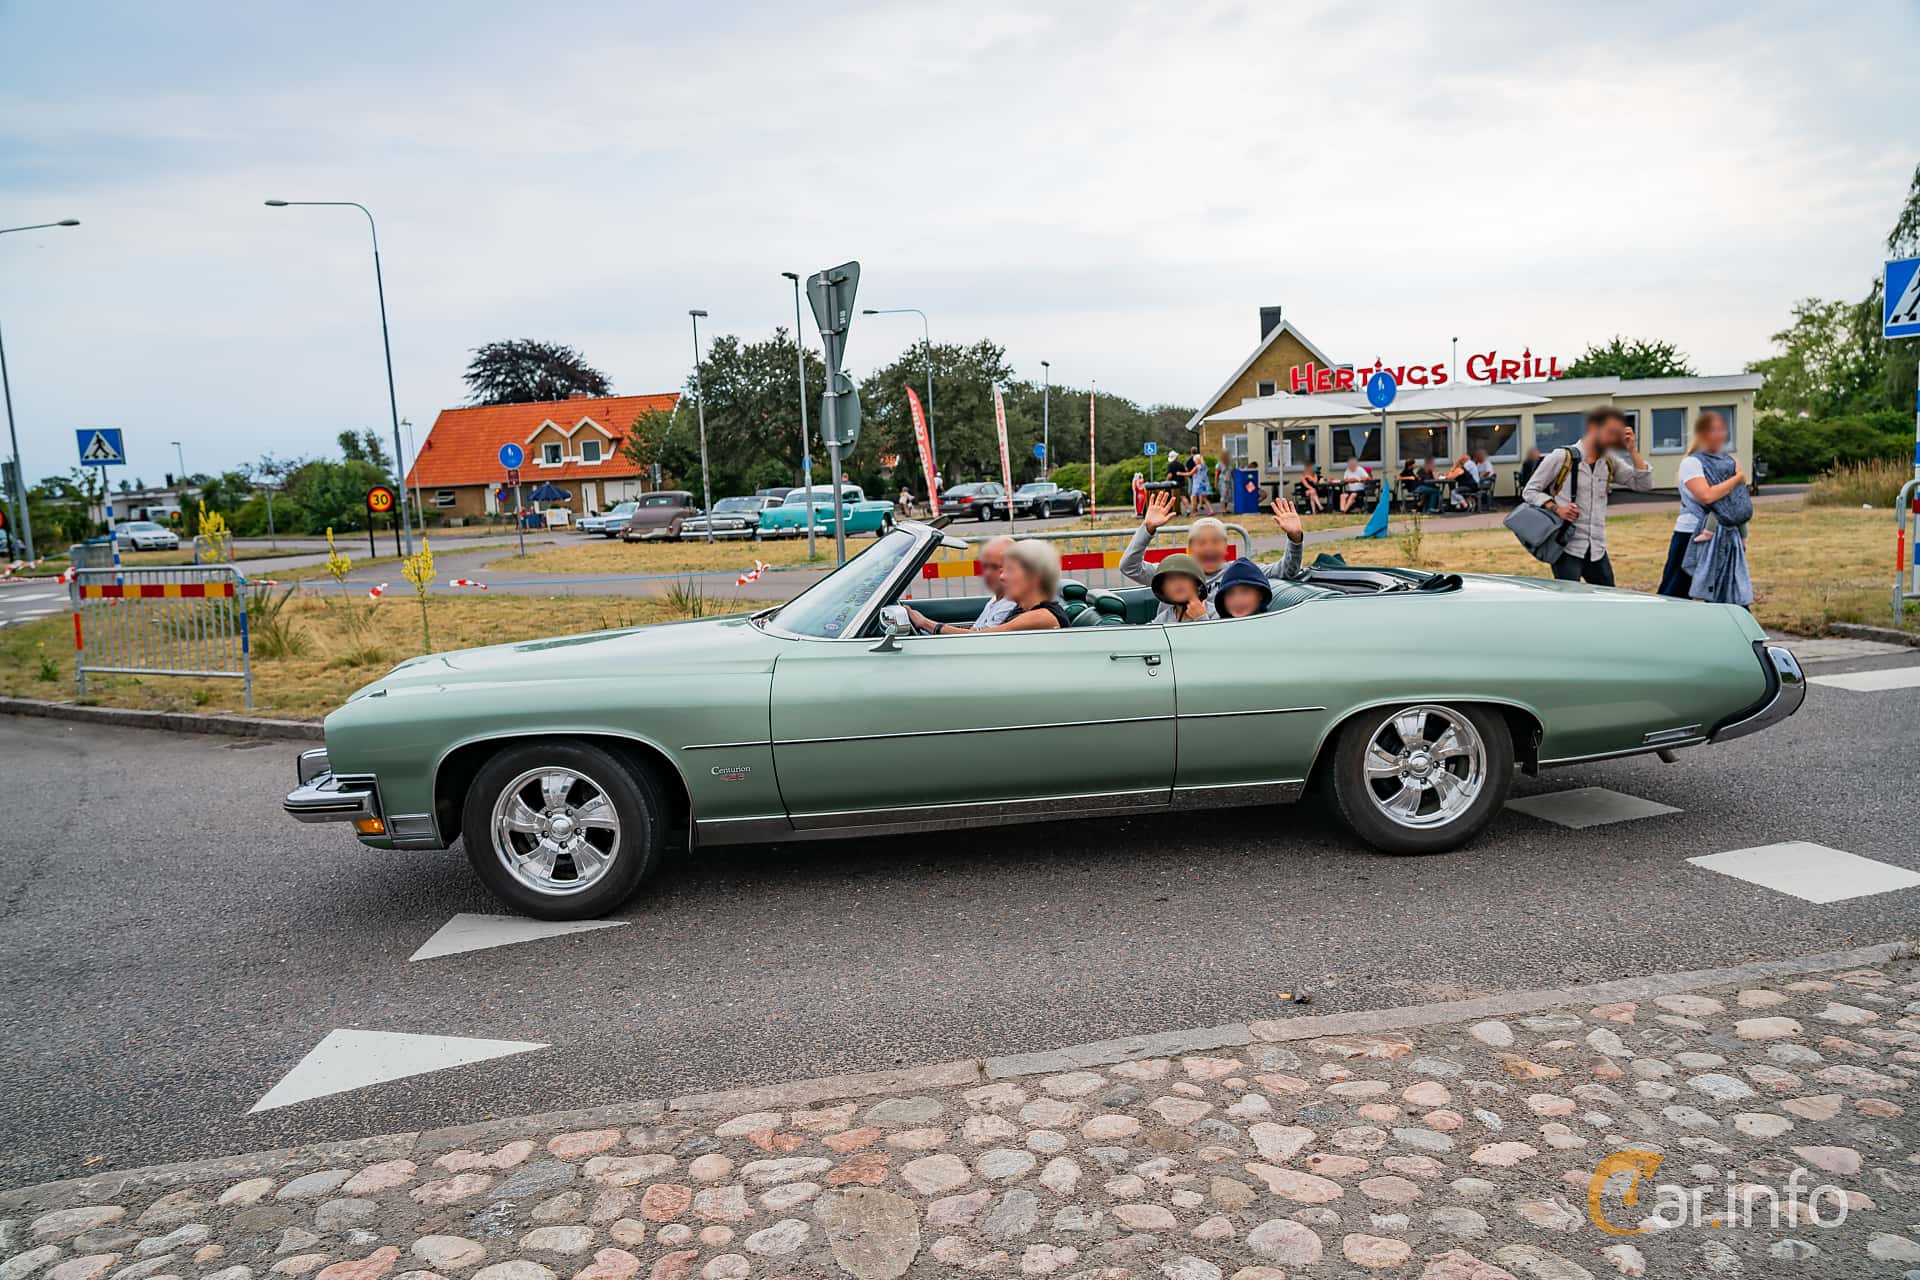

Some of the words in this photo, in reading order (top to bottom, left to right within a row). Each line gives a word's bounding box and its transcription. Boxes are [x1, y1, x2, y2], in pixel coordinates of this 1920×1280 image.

[1466, 347, 1563, 384] GRILL
[373, 494, 389, 506] 30
[711, 765, 751, 775] Centurion
